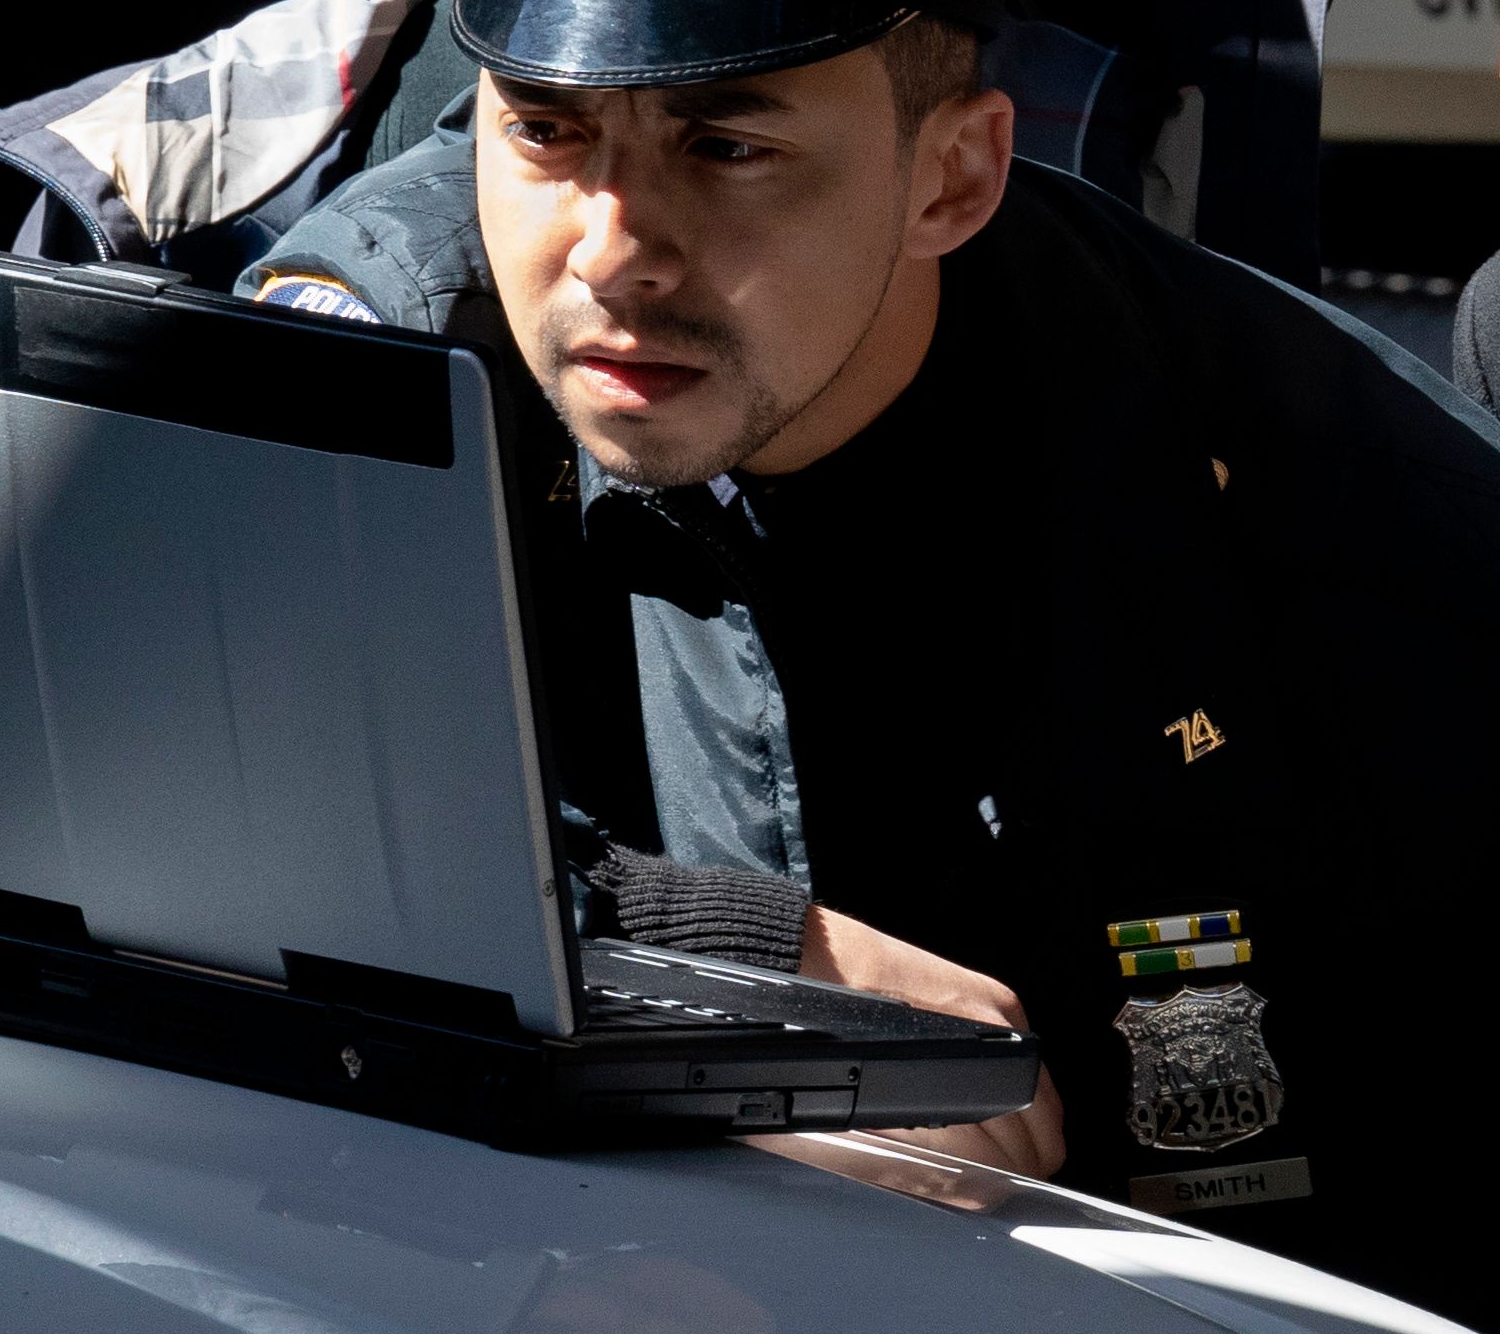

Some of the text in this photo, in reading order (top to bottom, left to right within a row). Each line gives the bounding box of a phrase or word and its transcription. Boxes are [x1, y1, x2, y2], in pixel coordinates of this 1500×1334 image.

[1164, 708, 1226, 764] 74
[1130, 1083, 1279, 1146] 923481
[1174, 1175, 1266, 1202] SMITH
